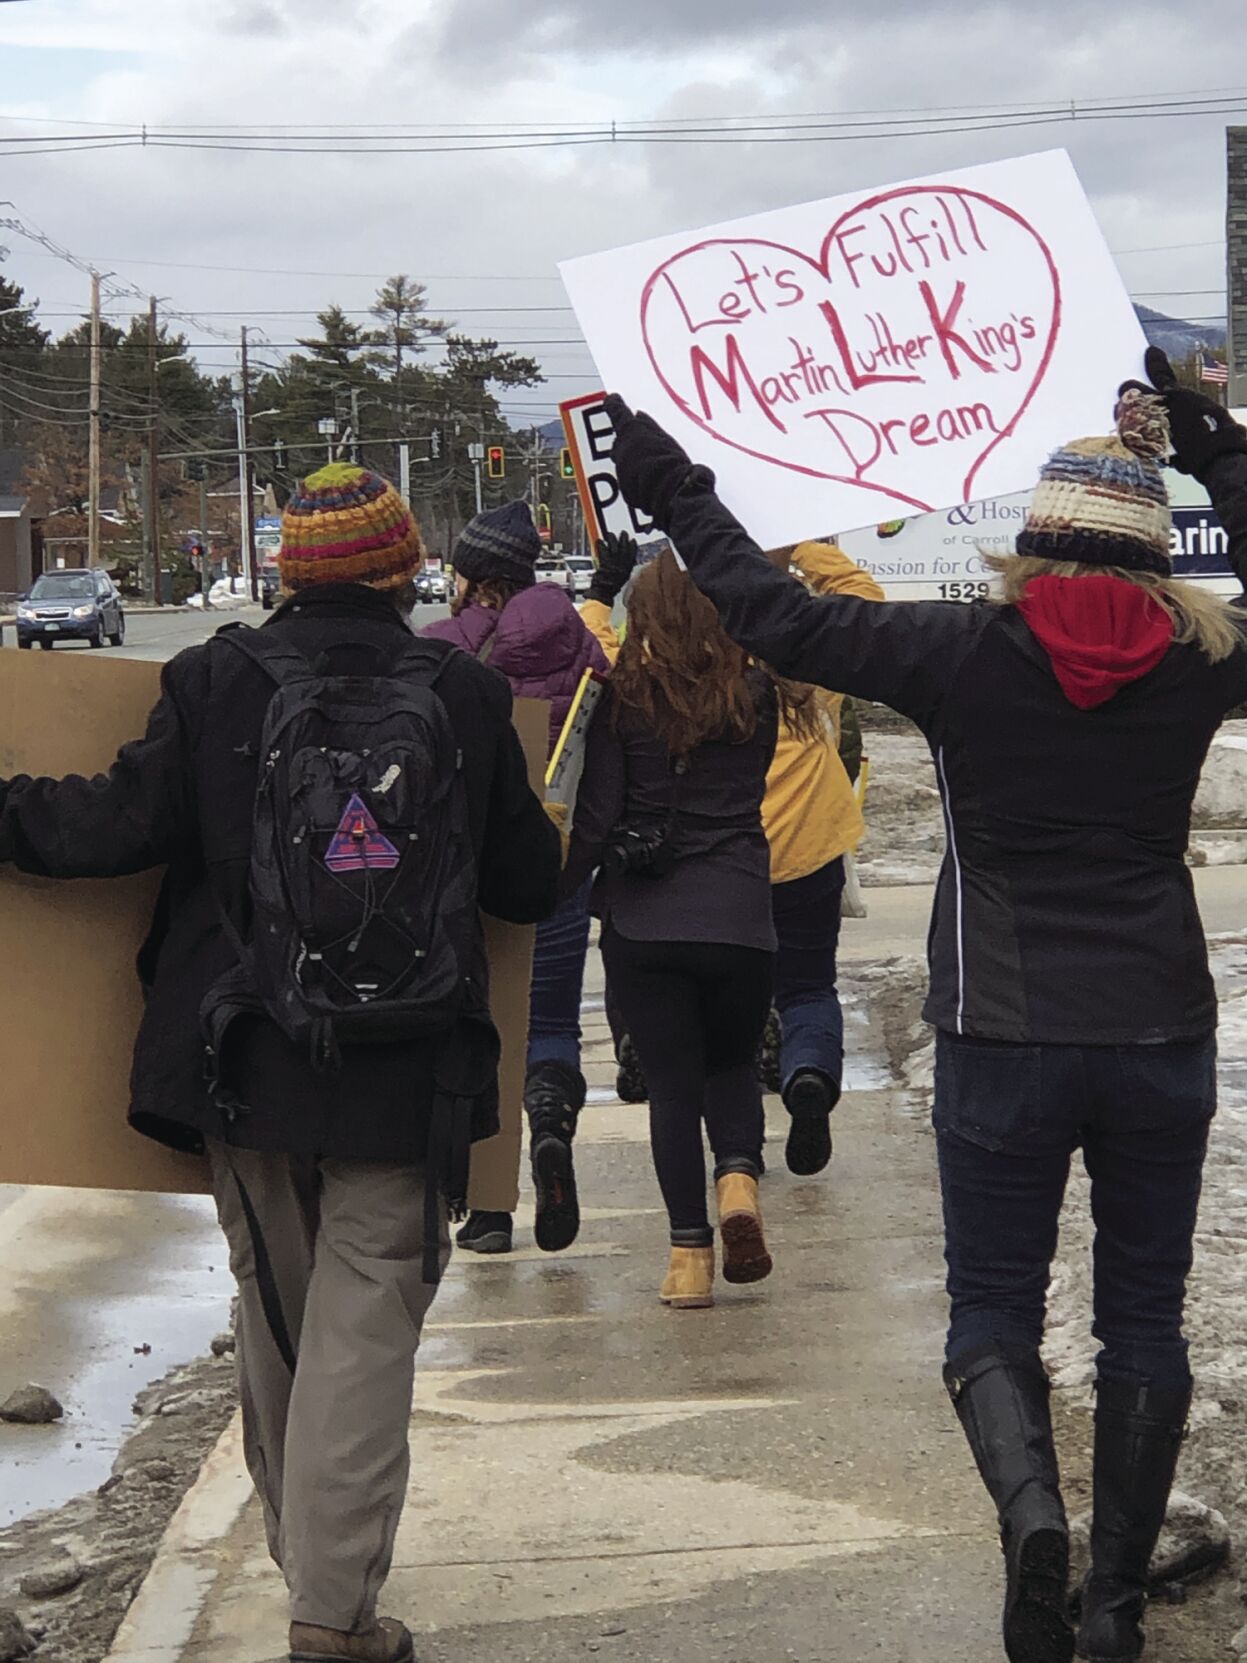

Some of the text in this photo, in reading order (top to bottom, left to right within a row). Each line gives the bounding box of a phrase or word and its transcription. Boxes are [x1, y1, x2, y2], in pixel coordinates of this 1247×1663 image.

[662, 196, 987, 333] Let's Fulfill
[690, 280, 1036, 434] Martin Luther King's
[803, 402, 1001, 479] Dream
[947, 505, 977, 525] &
[943, 536, 1009, 545] of Carroll
[932, 557, 960, 575] for
[938, 582, 990, 599] 1529
